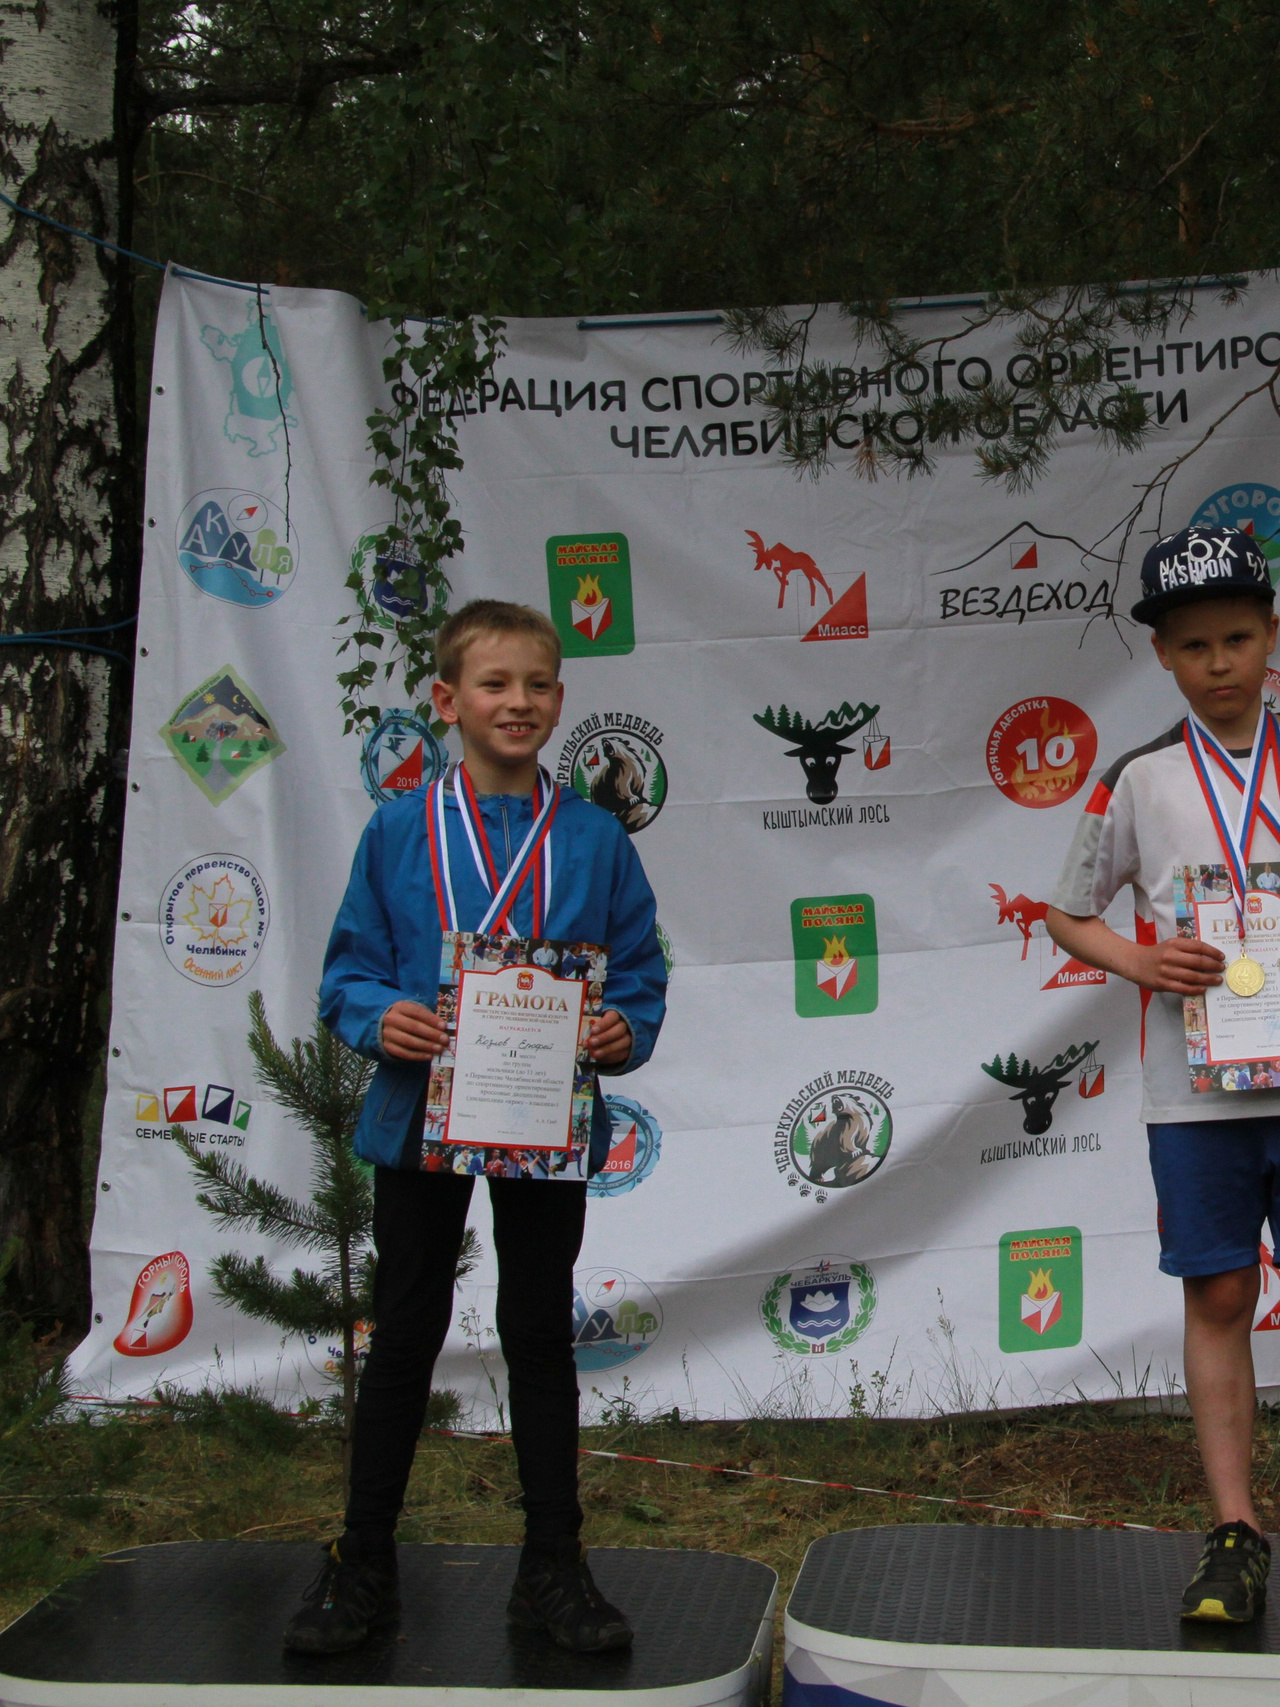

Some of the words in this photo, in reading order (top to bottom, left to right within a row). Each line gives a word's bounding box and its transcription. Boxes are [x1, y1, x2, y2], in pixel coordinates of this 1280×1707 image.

[556, 542, 619, 555] МАЙСКАЯ
[556, 554, 619, 567] ПОЛЯНА
[939, 580, 1114, 625] ВЕЗДЕХОД
[818, 622, 867, 638] Миасс
[557, 712, 602, 786] АРКУЛЬСКИЙ
[603, 712, 665, 746] МЕДВЕДЬ
[989, 730, 1008, 787] ГОРЯЧАЯ
[1000, 699, 1049, 732] ДЕСЯТКА
[1016, 735, 1076, 771] 10
[397, 777, 420, 787] 2016
[763, 804, 853, 830] КЫШТЫМСКИЙ
[165, 881, 185, 945] Открытое
[184, 860, 251, 881] первенство
[251, 877, 265, 916] СШОР
[802, 903, 865, 916] МАЙСКАЯ
[802, 915, 865, 928] ПОЛЯНА
[186, 944, 247, 957] Челябинск
[1057, 970, 1104, 984] Миасс
[474, 990, 569, 1012] ГРАМОТА
[509, 1050, 517, 1058] II
[774, 1070, 834, 1174] ЧЕБАРКУЛЬСКИЙ
[837, 1070, 895, 1100] МЕДВЕДЬ
[136, 1128, 207, 1144] СЕМЕЫЕ
[209, 1134, 246, 1147] СТАРТЫ
[980, 1134, 1067, 1165] КЫШТЫМСКИЙ
[604, 1160, 631, 1170] 2016
[1010, 1236, 1072, 1250] МАЙСКАЯ
[1010, 1248, 1072, 1261] ПОЛЯНА
[790, 1275, 852, 1287] ЧЕБАРКУЛЬ
